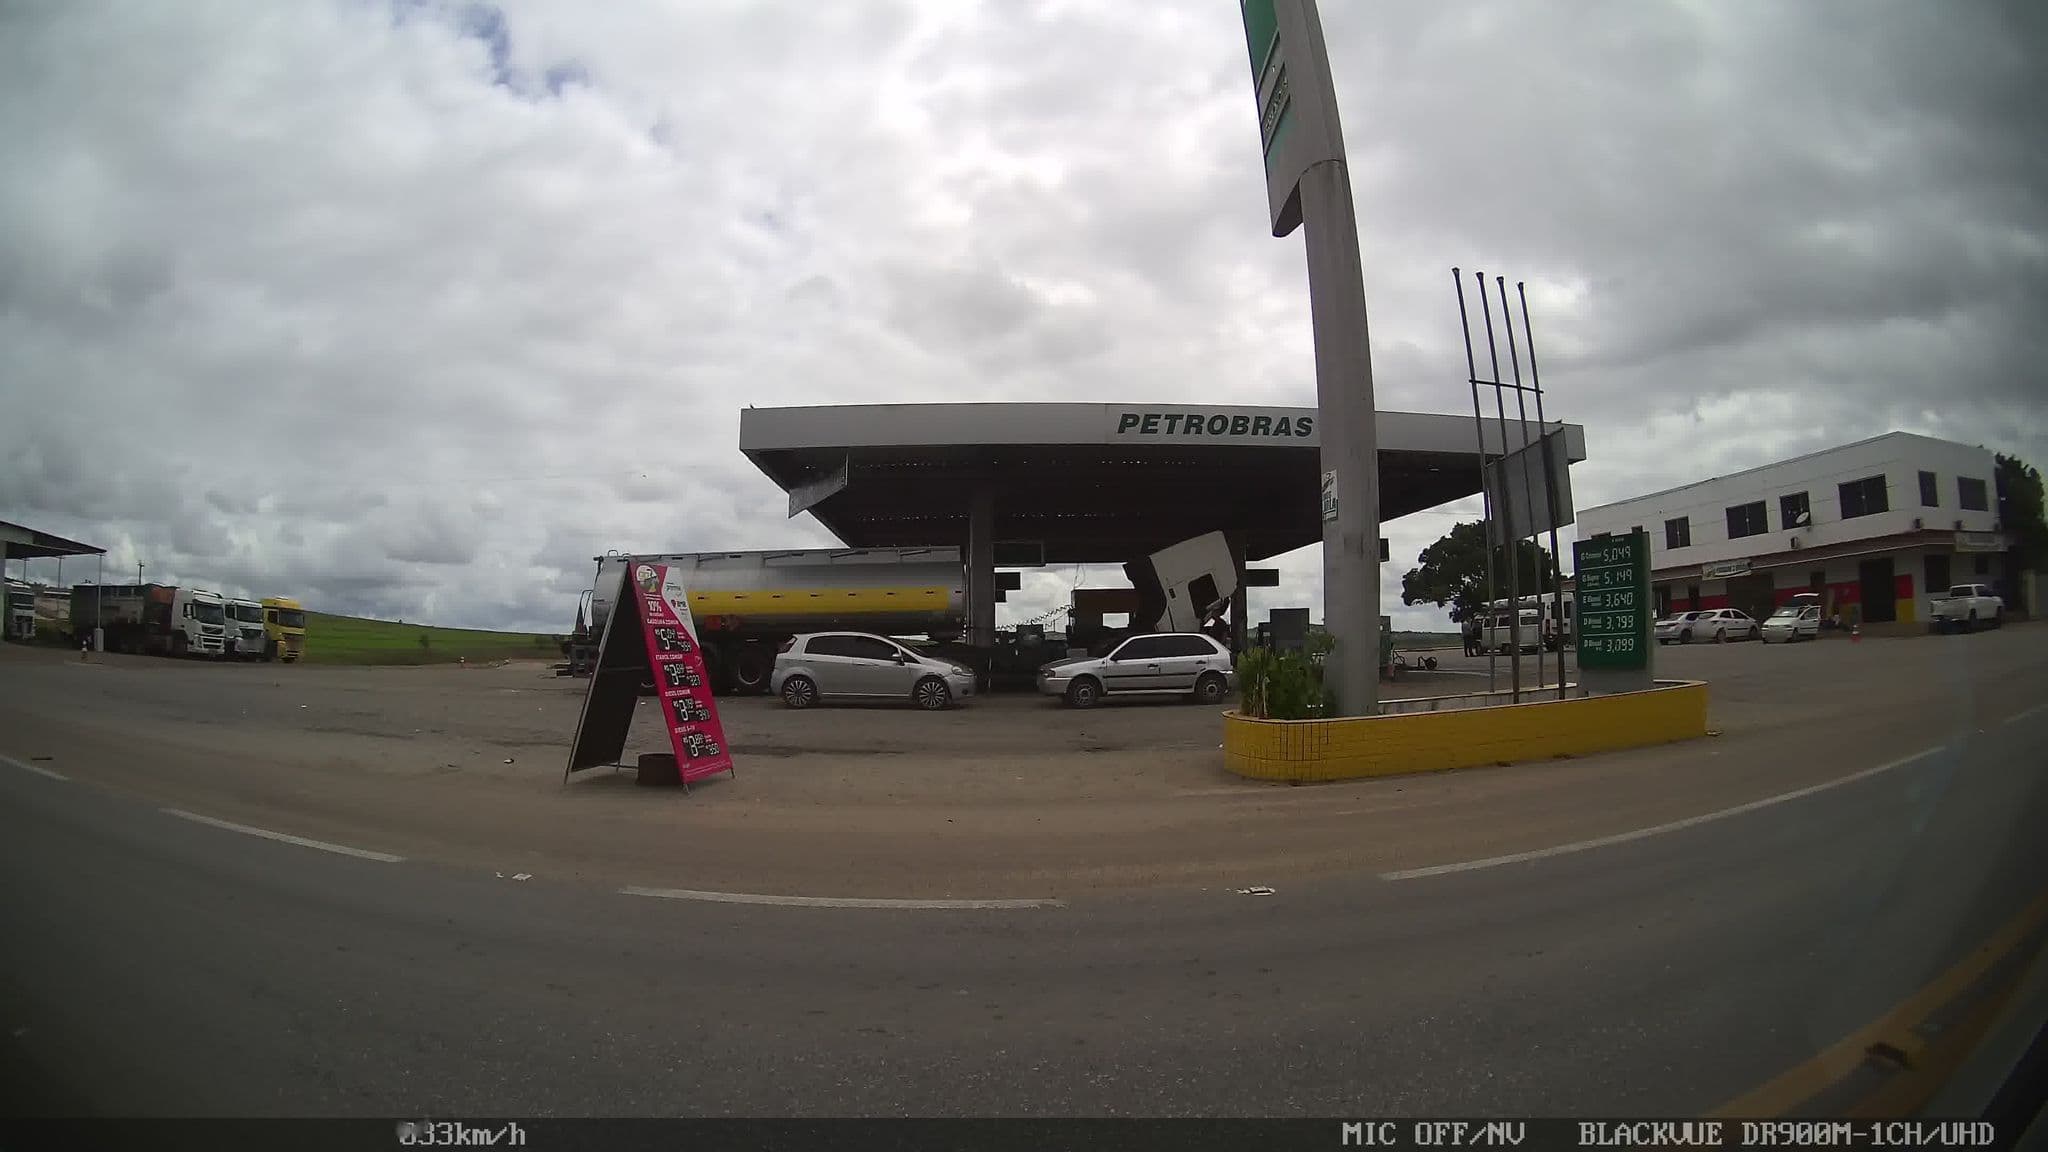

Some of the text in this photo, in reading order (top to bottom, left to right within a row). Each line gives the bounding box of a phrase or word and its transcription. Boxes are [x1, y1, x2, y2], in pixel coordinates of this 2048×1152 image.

[1117, 413, 1314, 437] PETROBRAS
[1603, 546, 1631, 562] 5,049
[1604, 568, 1632, 585] 5,149
[1605, 592, 1633, 608] 3,640
[1606, 638, 1634, 653] 3,099
